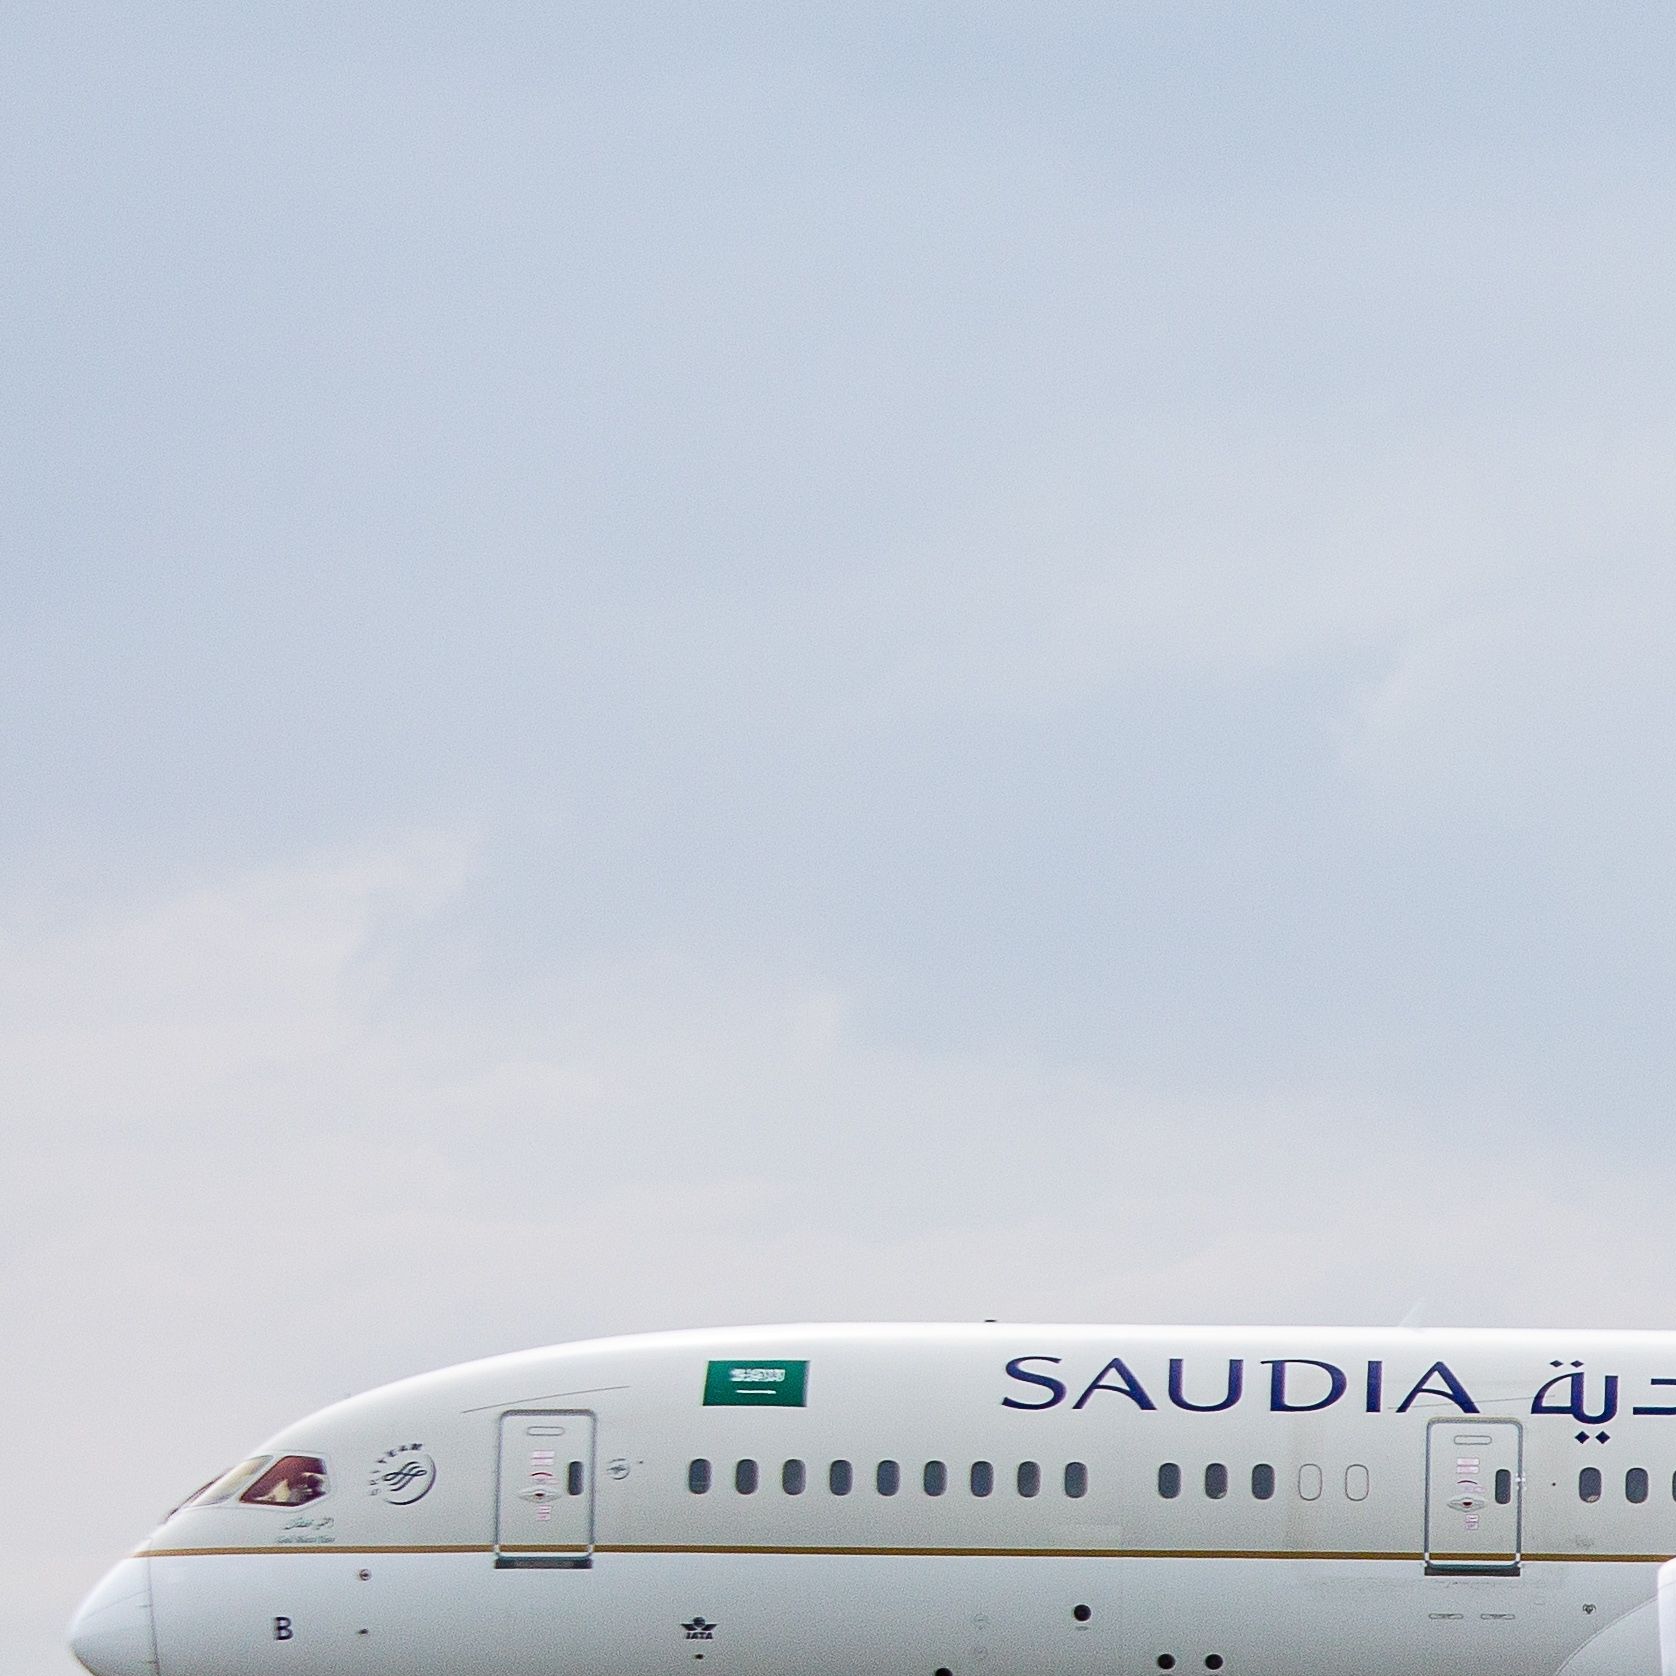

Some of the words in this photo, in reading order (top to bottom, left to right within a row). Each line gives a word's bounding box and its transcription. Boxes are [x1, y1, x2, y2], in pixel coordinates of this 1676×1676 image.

[1000, 1355, 1481, 1414] SAUDIA
[274, 1616, 294, 1641] B
[685, 1631, 714, 1640] IATA
